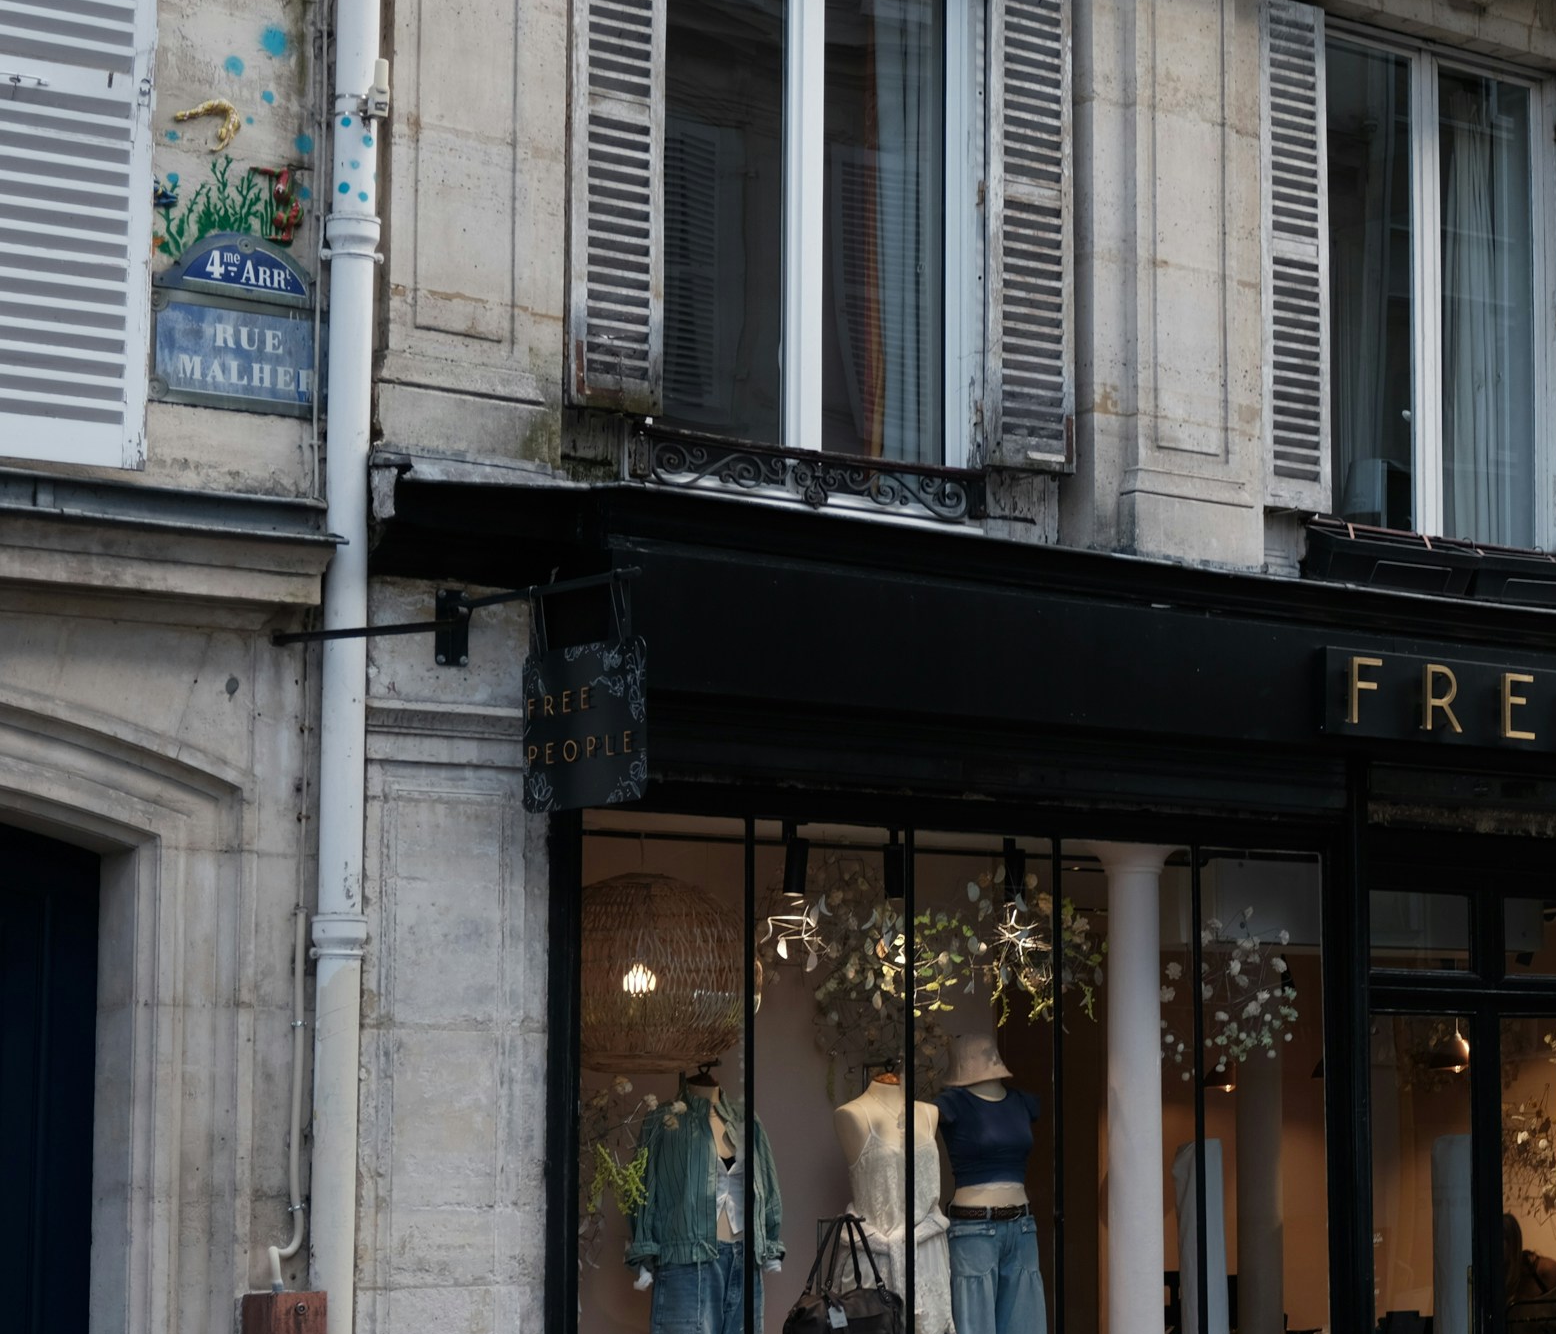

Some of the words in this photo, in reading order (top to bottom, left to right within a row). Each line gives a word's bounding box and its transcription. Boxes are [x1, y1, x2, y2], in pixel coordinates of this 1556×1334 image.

[214, 322, 284, 355] RUE
[527, 686, 591, 720] FREE
[527, 730, 633, 766] PEOPLE
